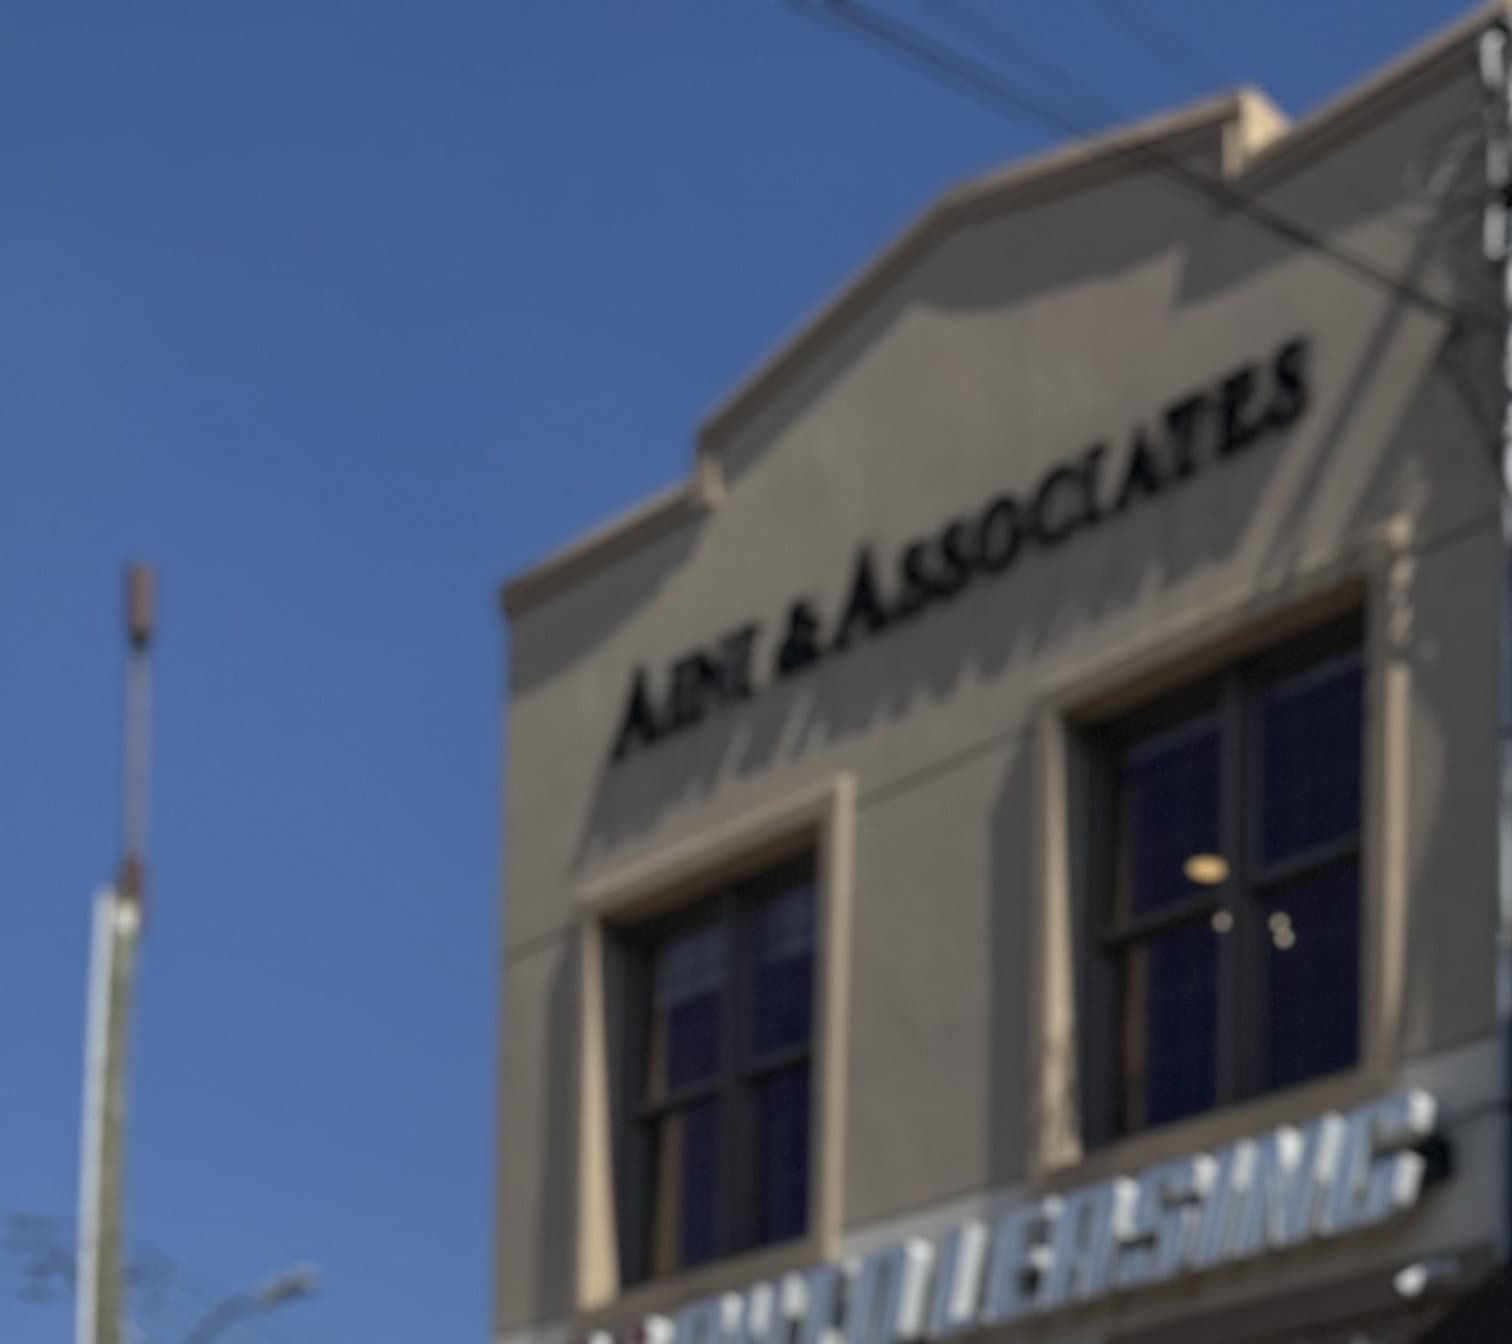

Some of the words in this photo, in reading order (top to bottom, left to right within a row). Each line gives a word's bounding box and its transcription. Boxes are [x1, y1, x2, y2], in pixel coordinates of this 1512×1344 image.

[778, 599, 832, 675] &
[830, 338, 1312, 652] ASSOCIATES
[928, 1087, 1438, 1340] LEASING
